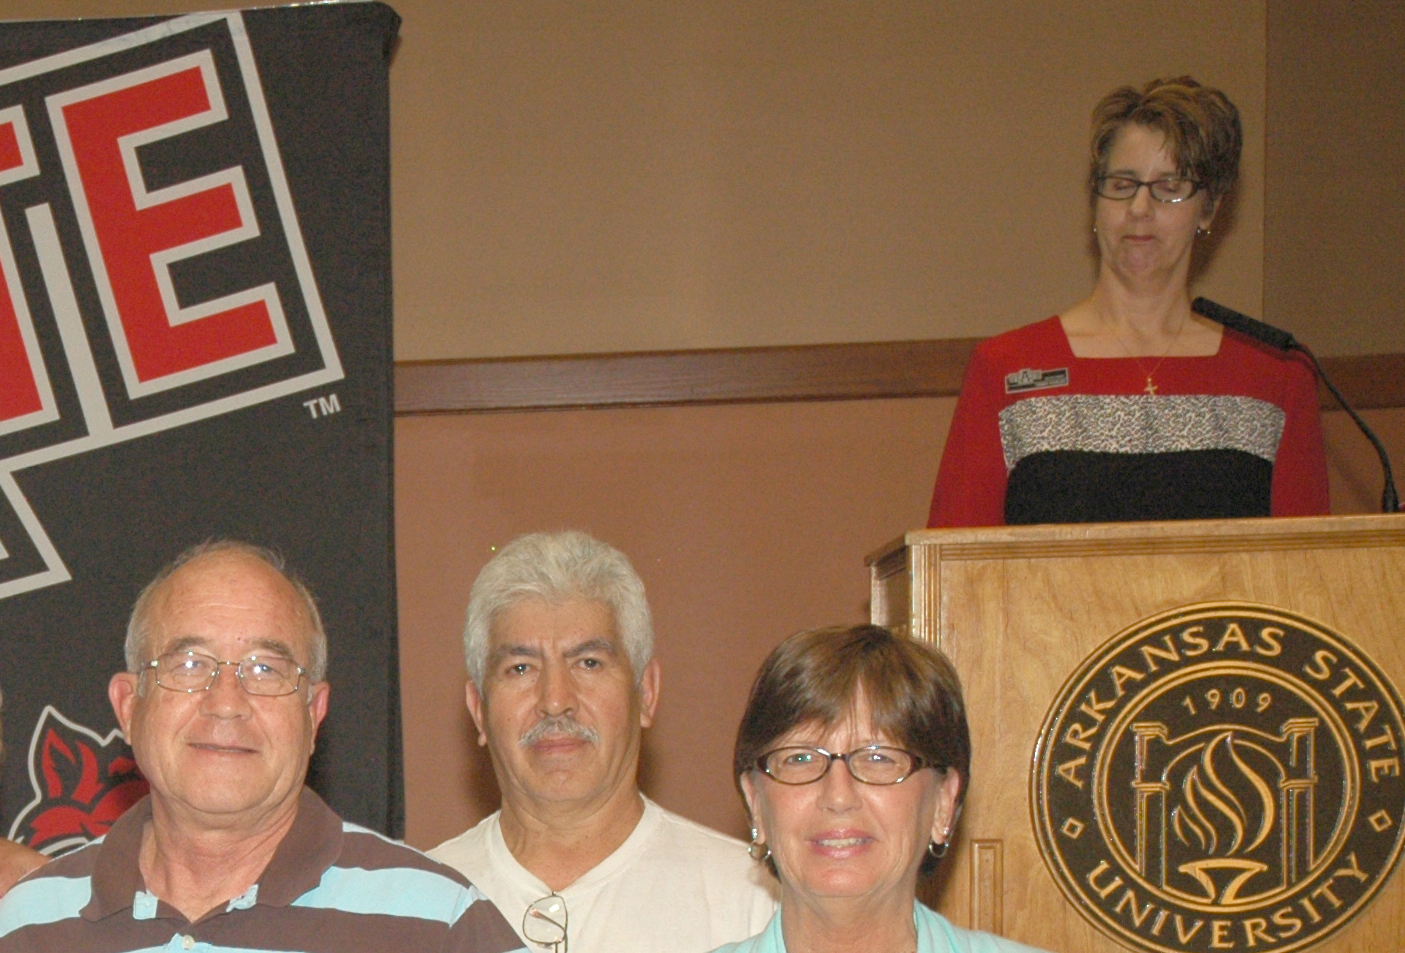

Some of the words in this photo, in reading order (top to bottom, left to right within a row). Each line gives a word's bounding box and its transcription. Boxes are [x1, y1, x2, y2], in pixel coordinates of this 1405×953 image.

[302, 393, 341, 419] TM
[1057, 622, 1285, 790] ARKANSAS
[1303, 648, 1401, 784] STATE
[1182, 687, 1272, 715] 1909
[1086, 851, 1370, 949] UNIVERSITY
